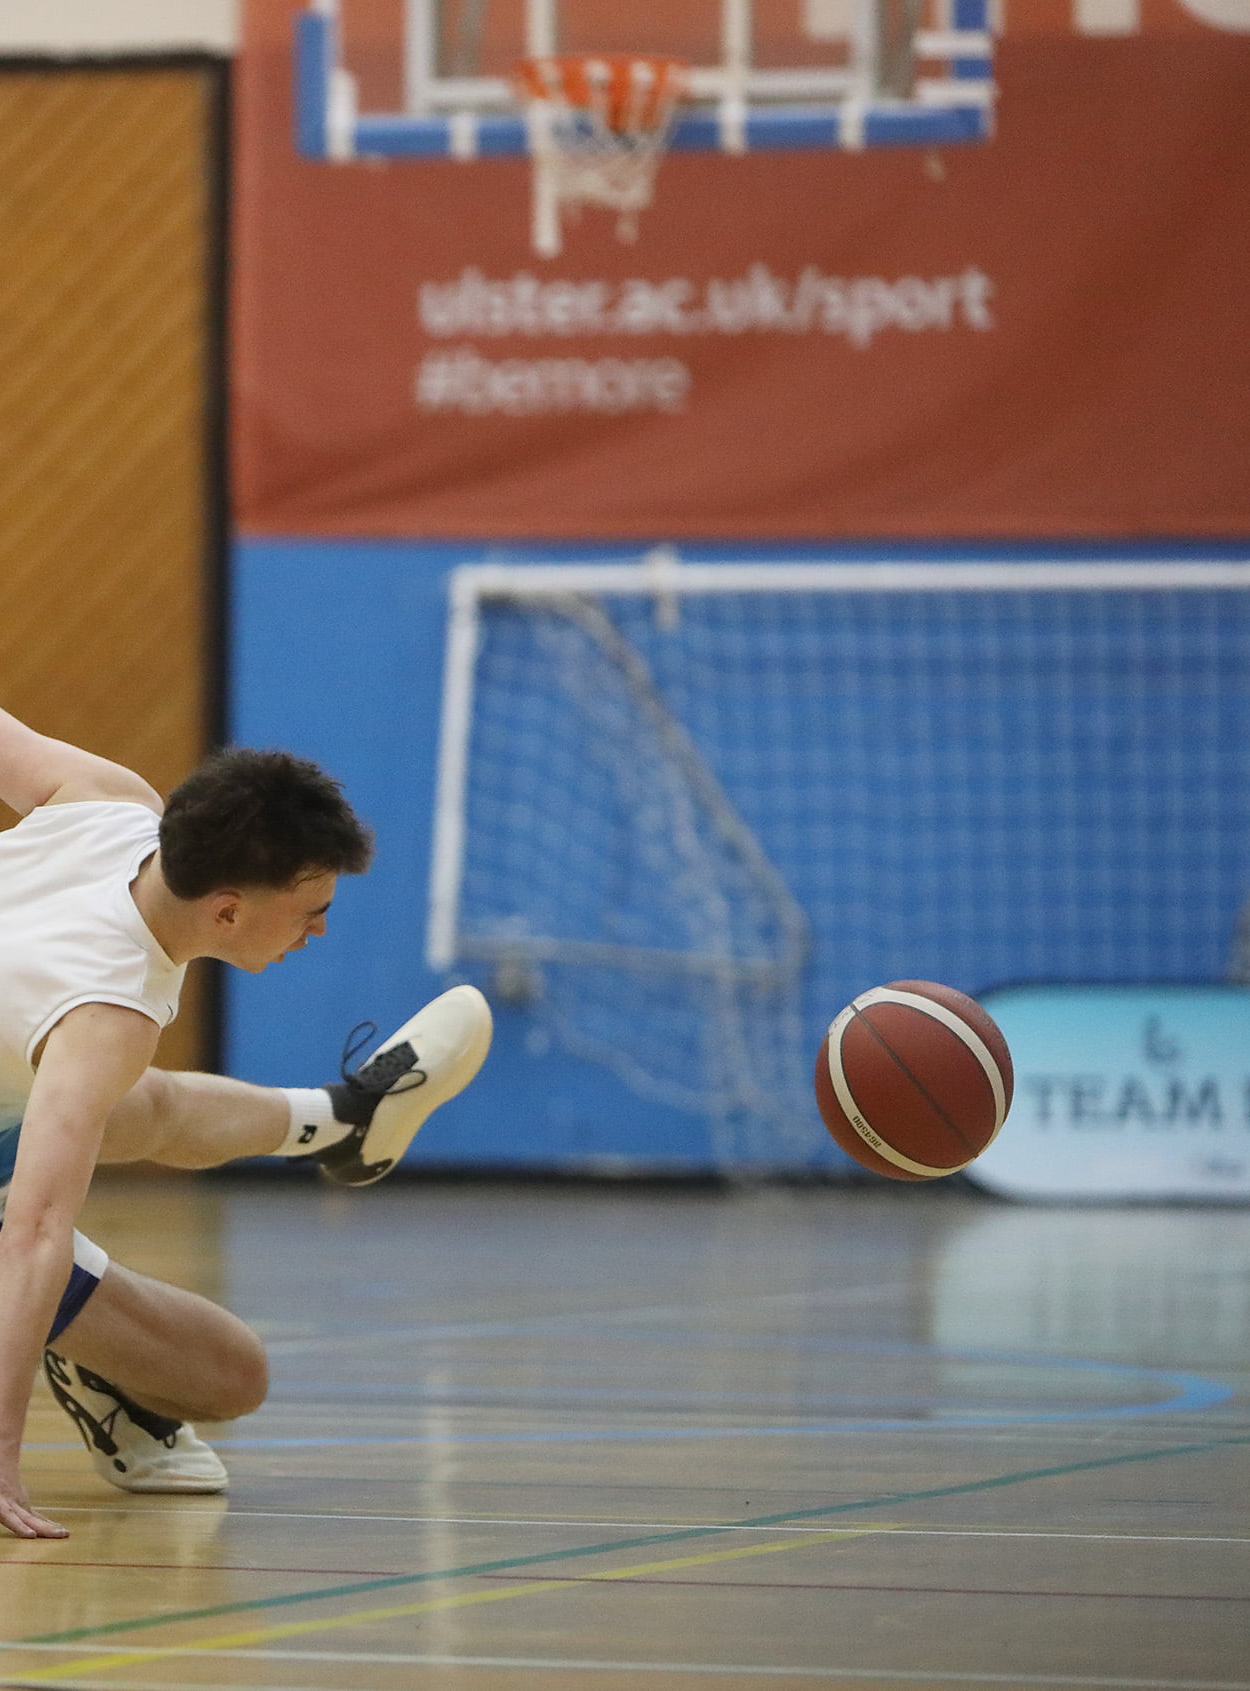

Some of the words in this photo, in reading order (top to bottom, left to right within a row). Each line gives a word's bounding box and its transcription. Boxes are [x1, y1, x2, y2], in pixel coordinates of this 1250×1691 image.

[418, 266, 993, 349] ulster.ac.uk/sport
[416, 347, 690, 413] #bemore
[1025, 1074, 1223, 1130] TEAM
